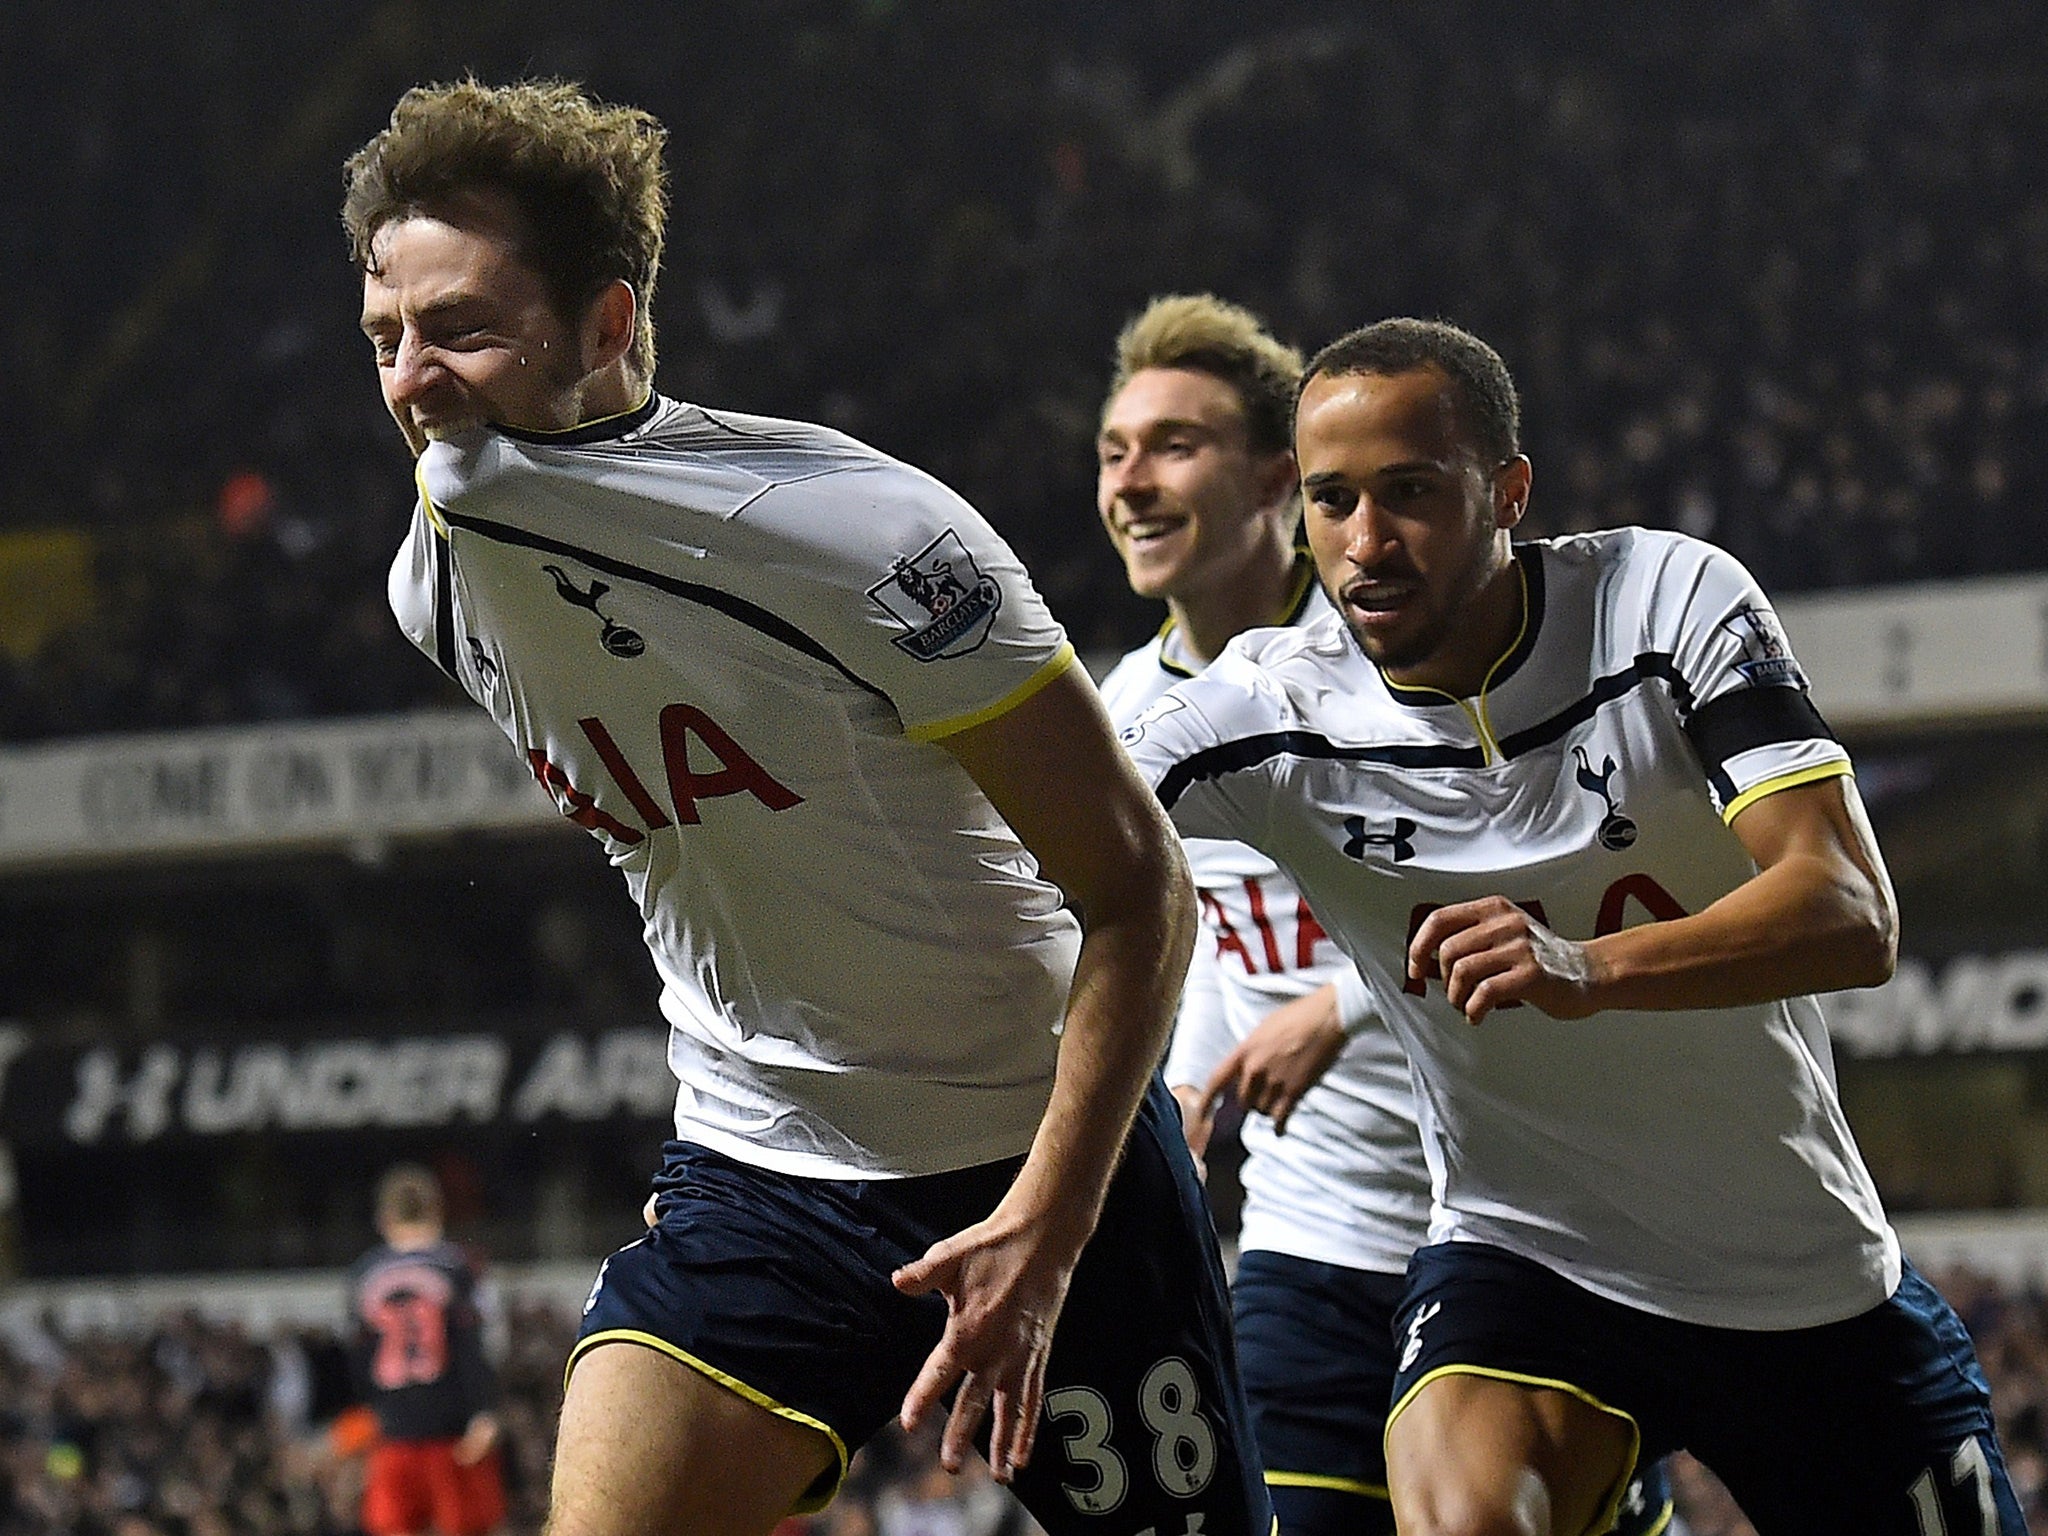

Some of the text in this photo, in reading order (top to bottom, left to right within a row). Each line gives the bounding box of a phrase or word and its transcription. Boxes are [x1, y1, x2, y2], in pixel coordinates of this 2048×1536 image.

[919, 598, 980, 647] BARCLAYS
[528, 703, 806, 846] AIA
[184, 1034, 506, 1132] UNDER
[1043, 1355, 1217, 1516] 38
